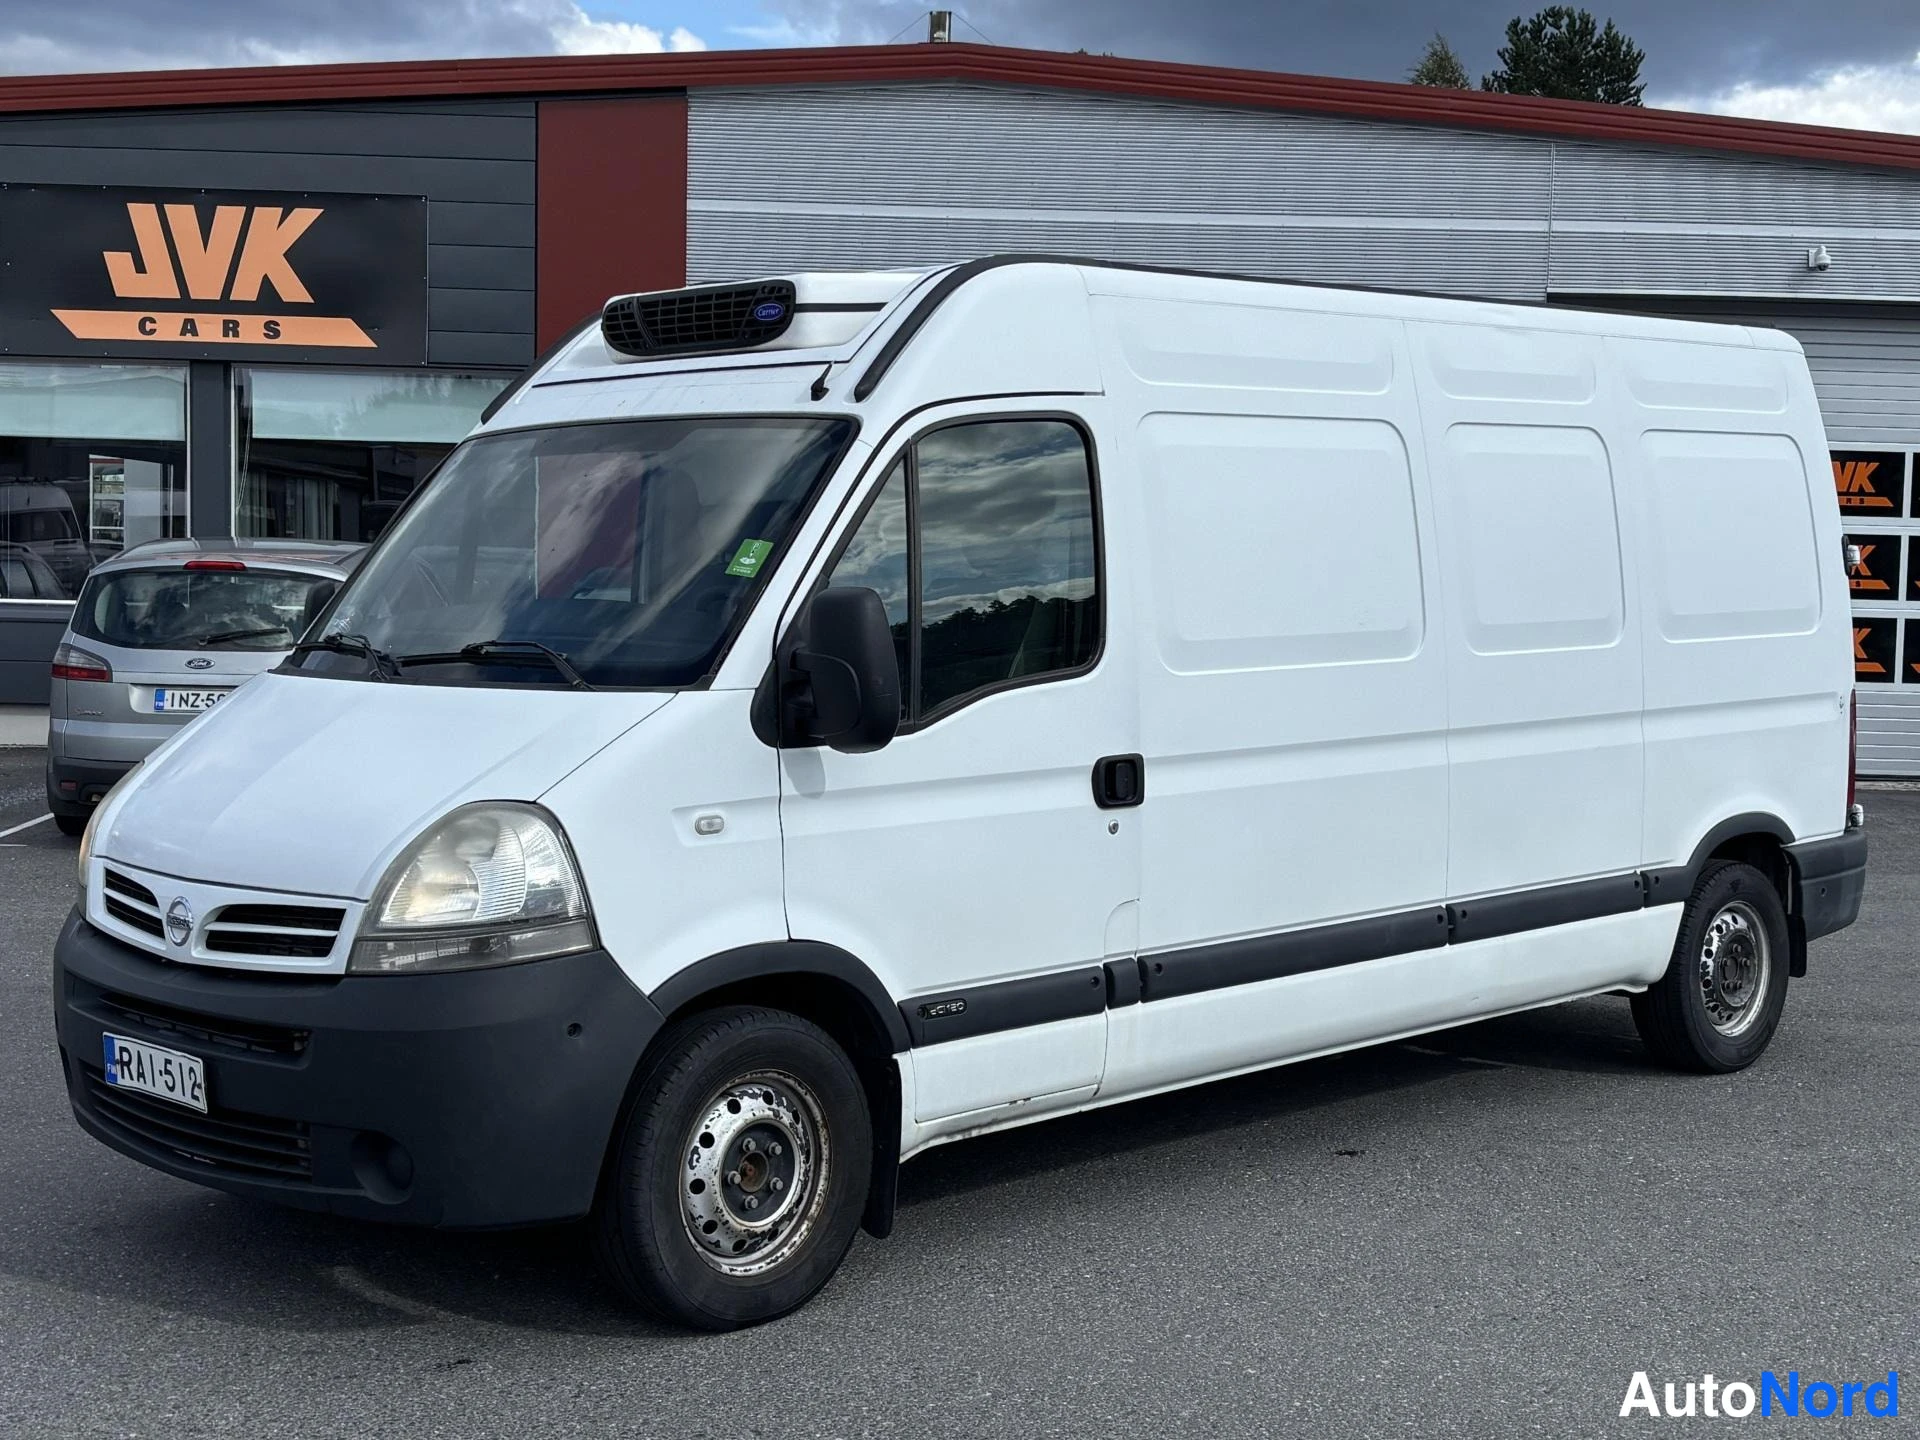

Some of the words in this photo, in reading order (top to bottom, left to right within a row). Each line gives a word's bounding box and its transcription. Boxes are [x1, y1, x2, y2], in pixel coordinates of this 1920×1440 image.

[102, 202, 325, 303] JVK
[138, 316, 282, 340] CARS
[1831, 461, 1880, 493] VK
[118, 1045, 201, 1102] RAI-512
